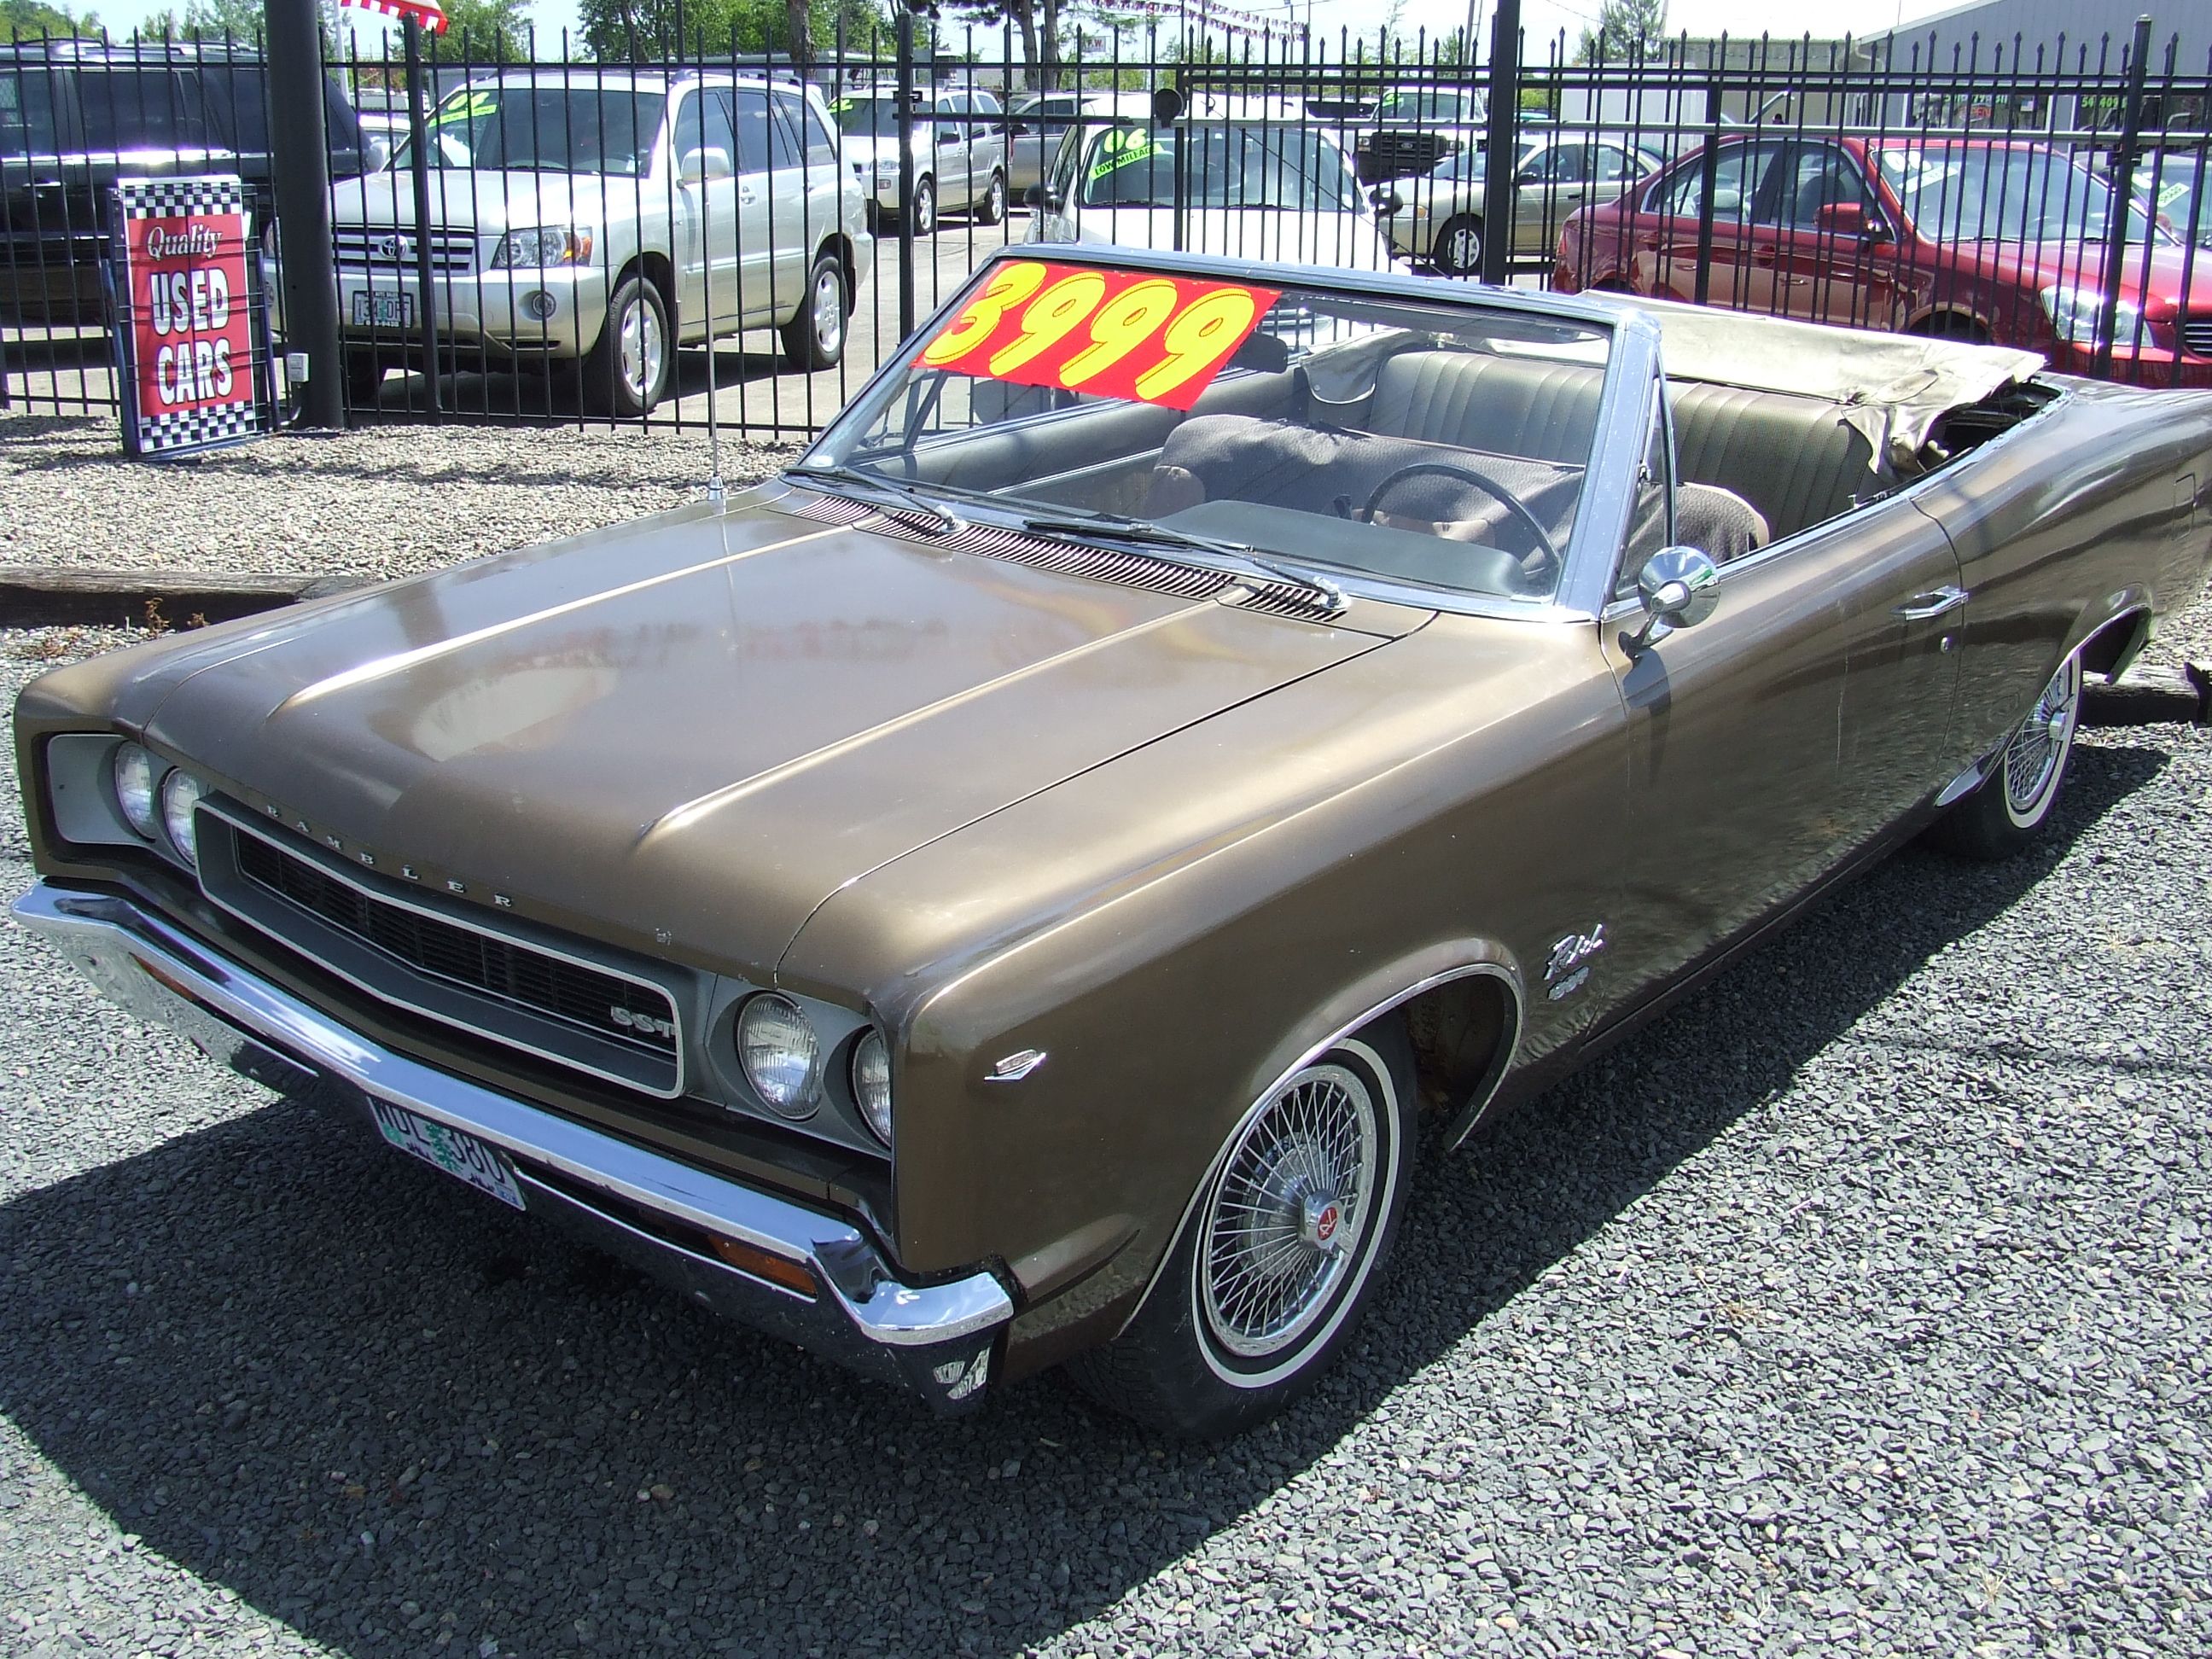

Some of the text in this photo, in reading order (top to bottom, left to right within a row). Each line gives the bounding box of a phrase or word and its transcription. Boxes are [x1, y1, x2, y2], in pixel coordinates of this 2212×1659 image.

[1103, 128, 1147, 153] 06
[1117, 145, 1155, 165] MILEAG
[148, 224, 223, 261] Quality
[149, 267, 230, 336] USED
[923, 262, 1255, 401] 3999
[157, 336, 235, 406] CARS
[267, 805, 512, 907] RAMBLER
[611, 1006, 676, 1039] SST
